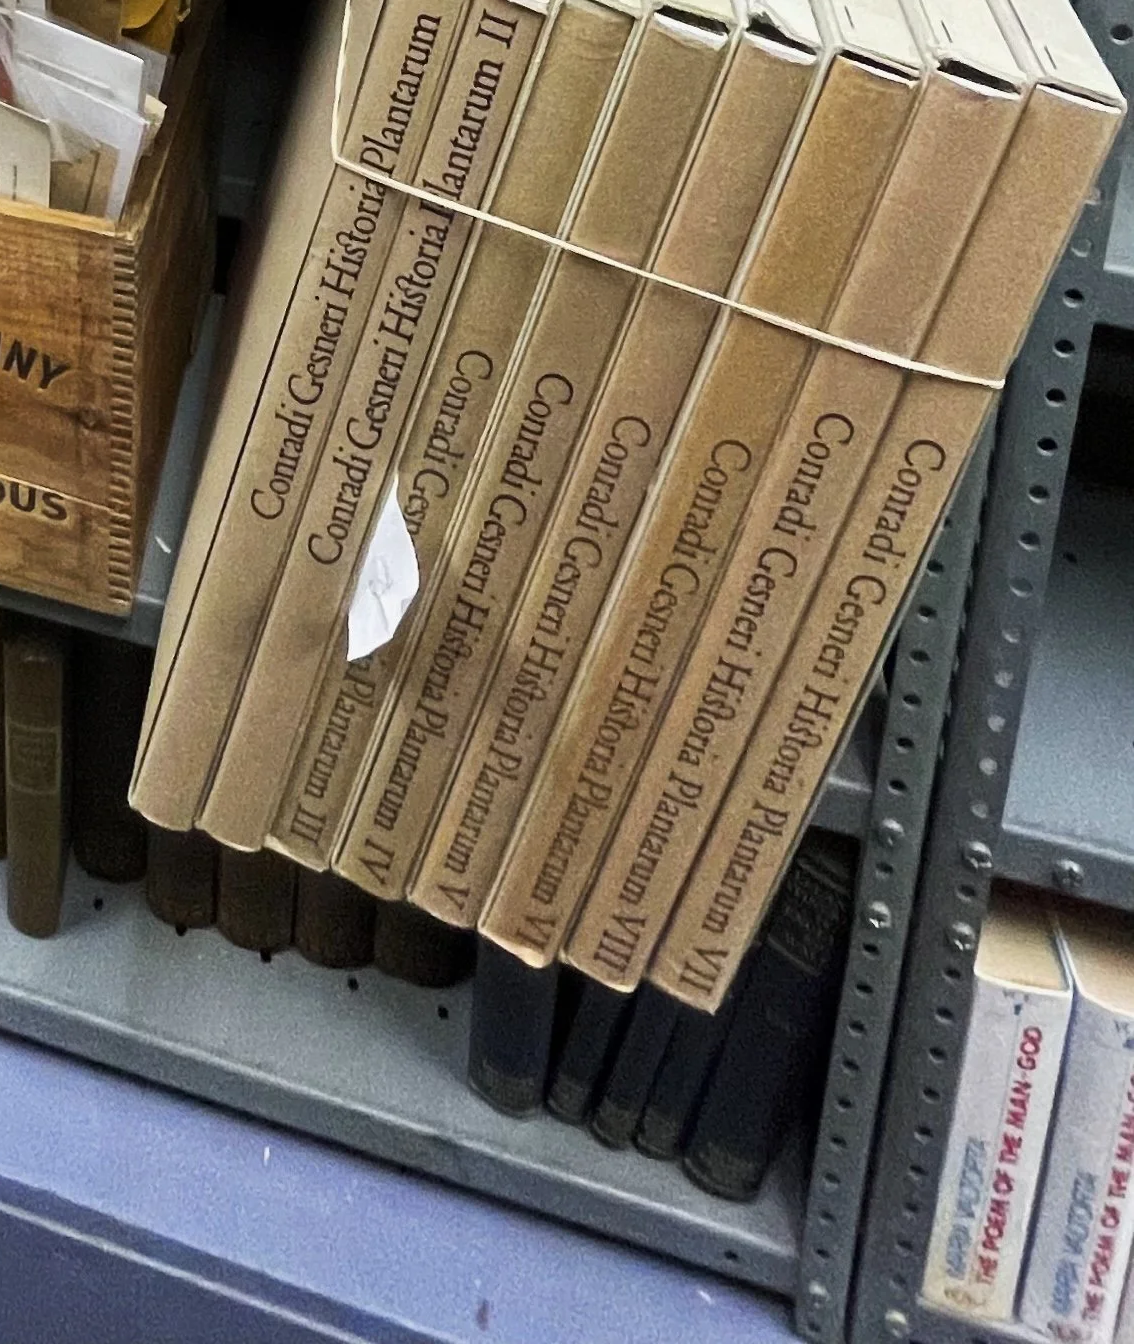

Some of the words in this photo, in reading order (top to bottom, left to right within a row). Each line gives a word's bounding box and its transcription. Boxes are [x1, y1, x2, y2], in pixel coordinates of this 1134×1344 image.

[251, 401, 314, 521] Conradi
[287, 296, 350, 405] Gesneri
[320, 176, 389, 309] Historia
[359, 13, 443, 178] Plantarum
[307, 443, 378, 567] Conradi
[346, 340, 409, 451] Gesneri
[380, 228, 454, 352] Historia
[421, 60, 504, 220] Plantarum
[476, 11, 519, 49] II
[422, 348, 495, 468] Conradi
[513, 372, 575, 496] Conradi
[585, 413, 653, 541] Conradi
[672, 437, 753, 566] Conradi
[772, 411, 855, 541] Conradi
[862, 438, 947, 568] Conradi
[460, 492, 528, 606] Gesneri
[532, 533, 604, 651] Gesneri
[725, 541, 799, 661] Gesneri
[427, 585, 493, 705] Historia
[627, 557, 702, 673] Gesneri
[811, 568, 887, 693] Gesneri
[500, 633, 566, 753] Historia
[587, 666, 660, 783] Historia
[677, 651, 755, 768] Historia
[762, 686, 842, 801] Historia
[372, 701, 450, 833] Plantarum
[445, 743, 525, 878] Plantarum
[289, 813, 327, 849] III
[360, 836, 397, 887] IV
[530, 776, 614, 911] Plantarum
[617, 766, 704, 911] Plantarum
[707, 796, 790, 937] Plantarum
[443, 881, 472, 913] V
[515, 911, 558, 955] VI
[592, 910, 647, 976] VIII
[679, 946, 732, 998] VII
[992, 1168, 1015, 1195] OF
